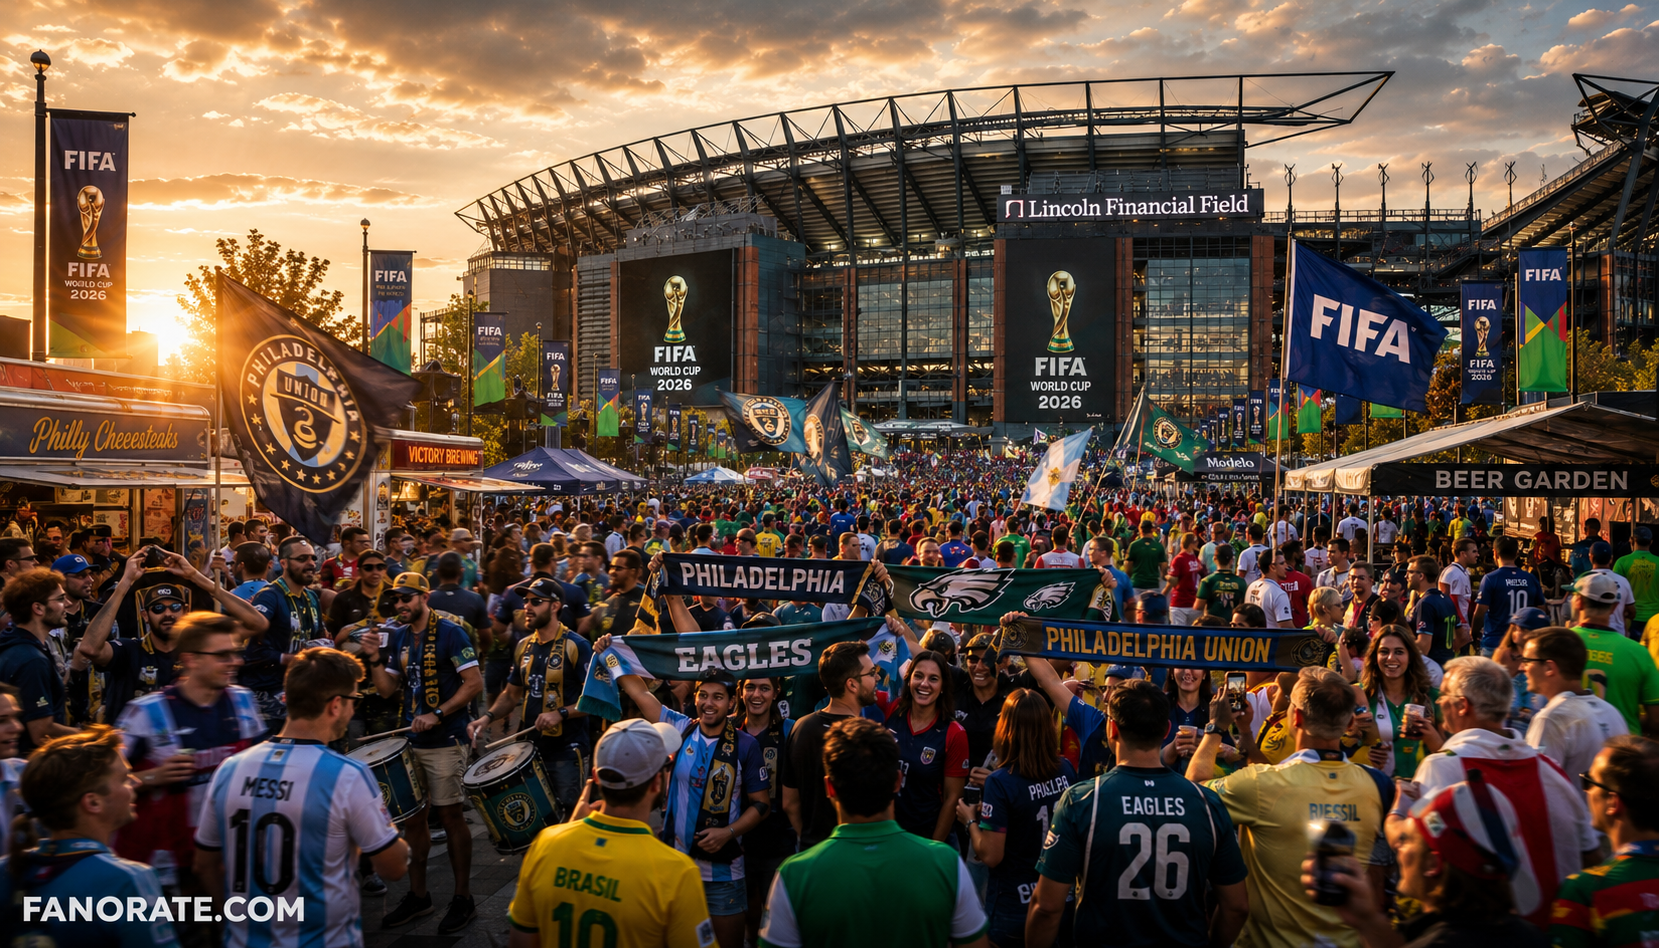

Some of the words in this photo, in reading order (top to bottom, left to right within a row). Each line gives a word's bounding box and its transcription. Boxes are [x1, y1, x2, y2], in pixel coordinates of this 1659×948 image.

[64, 150, 116, 172] FIFA
[1028, 199, 1101, 218] Lincoln
[1105, 196, 1195, 216] Financial
[1199, 193, 1249, 214] Field
[67, 262, 111, 278] FIFA
[374, 270, 407, 283] FIFA
[1524, 268, 1562, 282] FIFA
[70, 289, 107, 300] 2026
[1467, 299, 1497, 311] FIFA
[477, 326, 502, 336] FIFA
[1310, 293, 1411, 364] FIFA
[546, 352, 565, 360] FIFA
[654, 345, 697, 363] FIFA
[1469, 359, 1495, 368] FIFA
[650, 366, 681, 376] WORLD
[682, 366, 701, 376] CUP
[1034, 357, 1088, 376] FIFA
[657, 378, 693, 391] 2026
[1030, 381, 1067, 392] WORLD
[1070, 381, 1092, 391] CUP
[1038, 395, 1082, 409] 2026
[29, 416, 91, 460] Philly
[94, 419, 179, 452] Cheeesteaks
[408, 445, 445, 464] VICTORY
[1206, 456, 1255, 468] Modelo
[1435, 470, 1504, 489] BEER
[1514, 470, 1629, 490] GARDEN
[679, 562, 845, 594] PHILADELPHIA
[1046, 625, 1196, 661] PHILADELPHIA
[1203, 635, 1272, 663] UNION
[674, 637, 813, 673] EAGLES
[240, 776, 295, 802] MESSI
[1121, 796, 1186, 817] EAGLES
[229, 808, 297, 896] 10
[1117, 822, 1191, 900] 26
[554, 866, 622, 902] BRASIL
